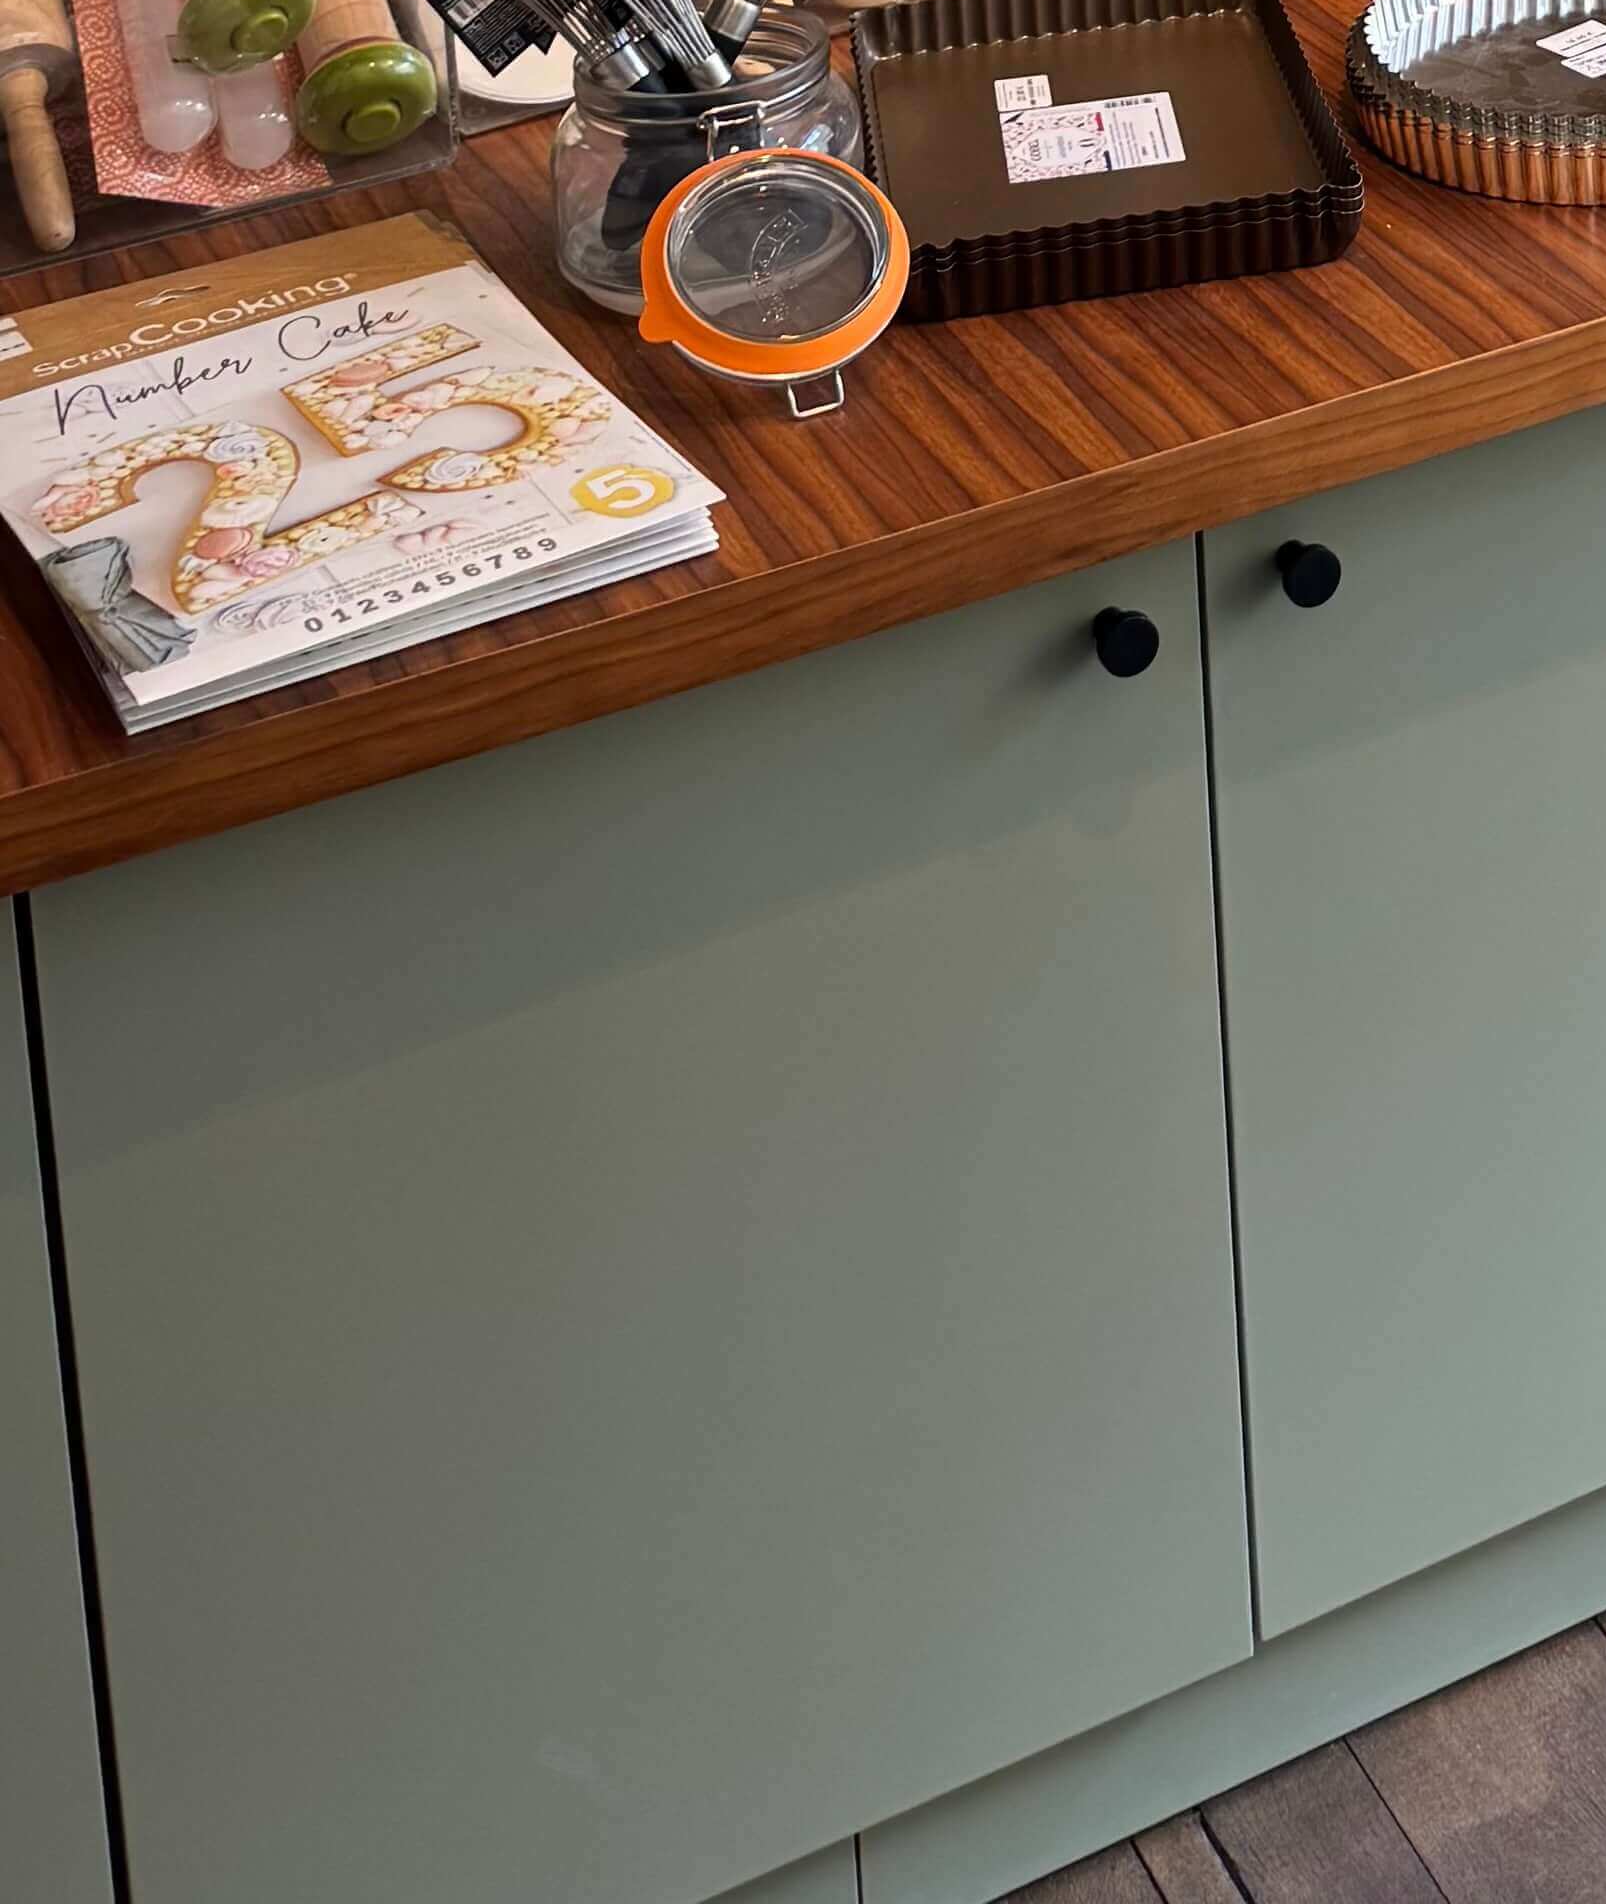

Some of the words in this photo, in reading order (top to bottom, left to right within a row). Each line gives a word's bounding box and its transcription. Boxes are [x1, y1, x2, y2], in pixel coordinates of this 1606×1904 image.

[32, 274, 351, 378] ScrapCooking
[54, 356, 253, 435] Number
[279, 301, 408, 361] Cake
[586, 469, 657, 510] 5
[303, 616, 324, 634] 0
[330, 607, 352, 623] 1
[357, 598, 380, 614] 2
[383, 590, 404, 604] 3
[410, 580, 432, 595] 4
[437, 571, 456, 586] 5
[463, 563, 483, 577] 6
[484, 554, 505, 569] 7
[513, 546, 534, 561] 8
[538, 537, 559, 552] 9
